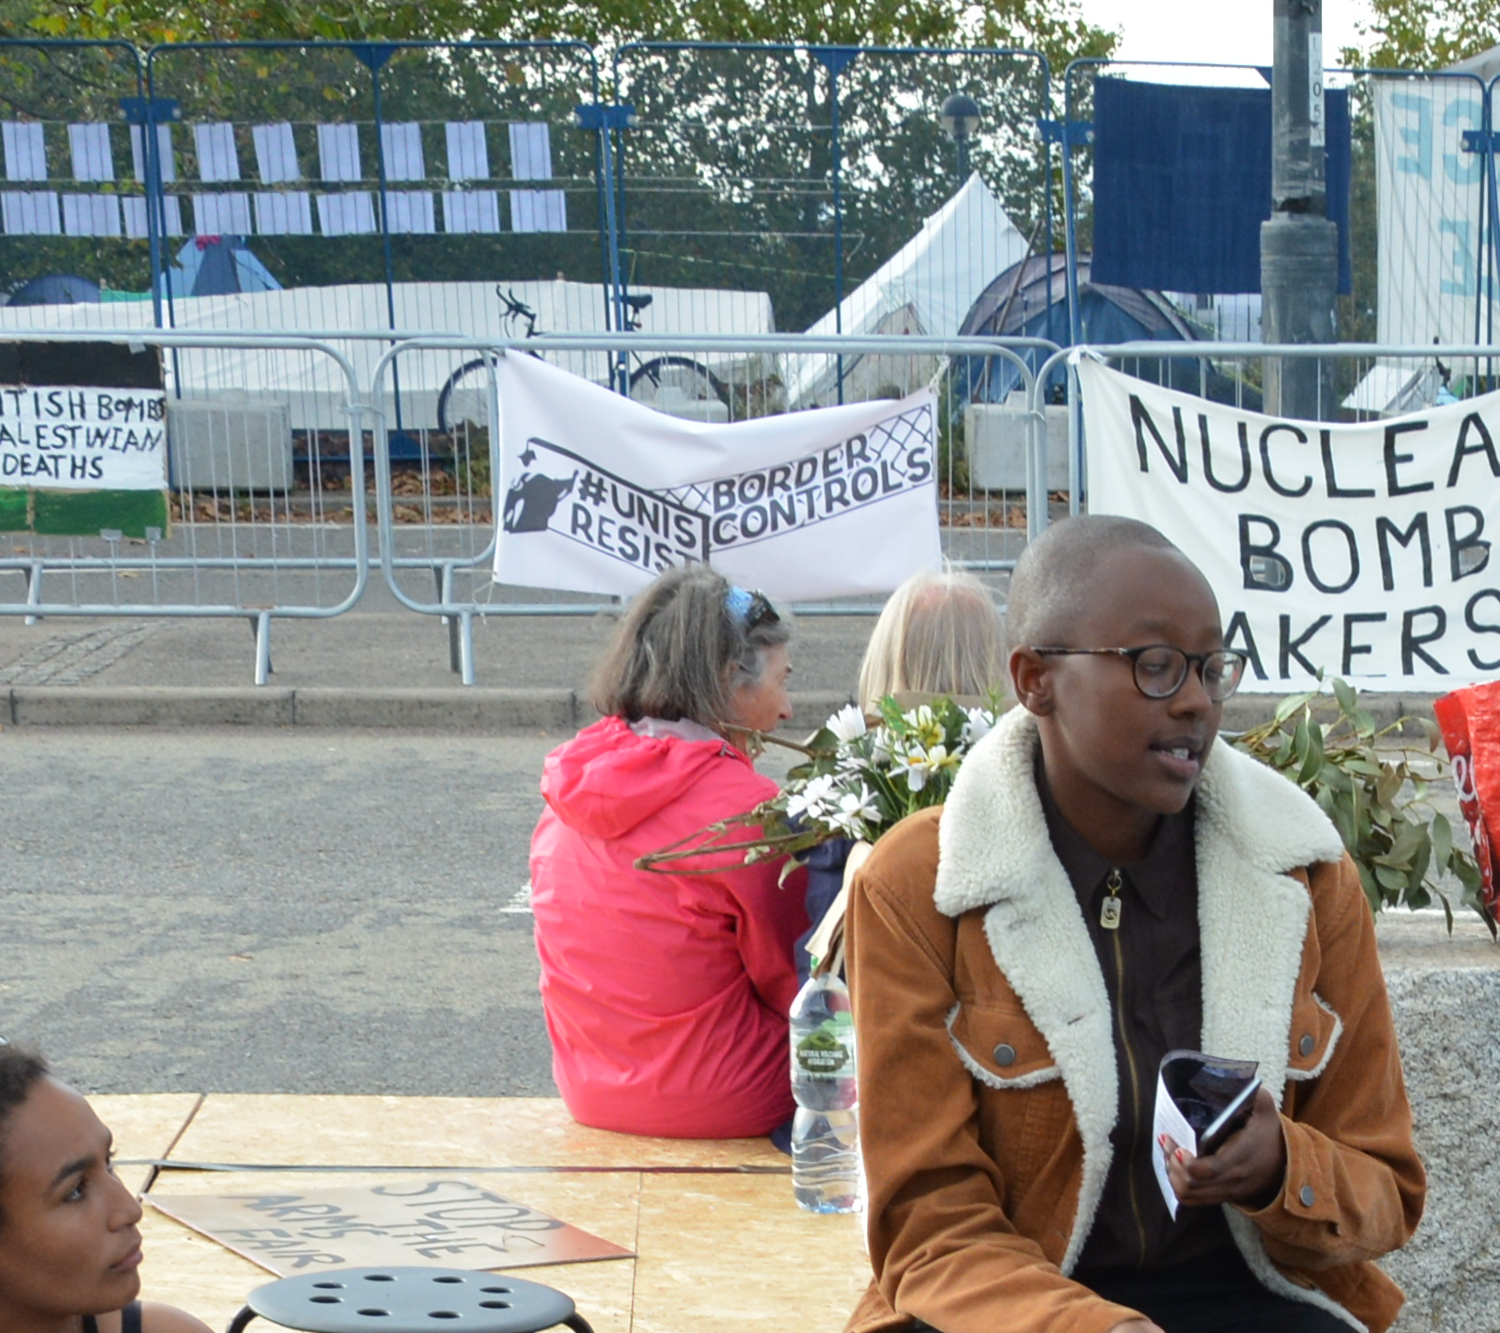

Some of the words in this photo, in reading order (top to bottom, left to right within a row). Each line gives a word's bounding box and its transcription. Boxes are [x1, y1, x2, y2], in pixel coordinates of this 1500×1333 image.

[97, 393, 165, 423] BOMBS
[2, 452, 104, 479] DEATHS
[712, 433, 871, 512] BORDER
[578, 471, 698, 548] #UNIS
[711, 447, 932, 546] CONTROLS
[1238, 505, 1491, 594] BOMB
[220, 1195, 388, 1240] ARMS
[371, 1180, 566, 1232] STOP
[210, 1228, 346, 1268] FAIR
[372, 1217, 508, 1260] THE
